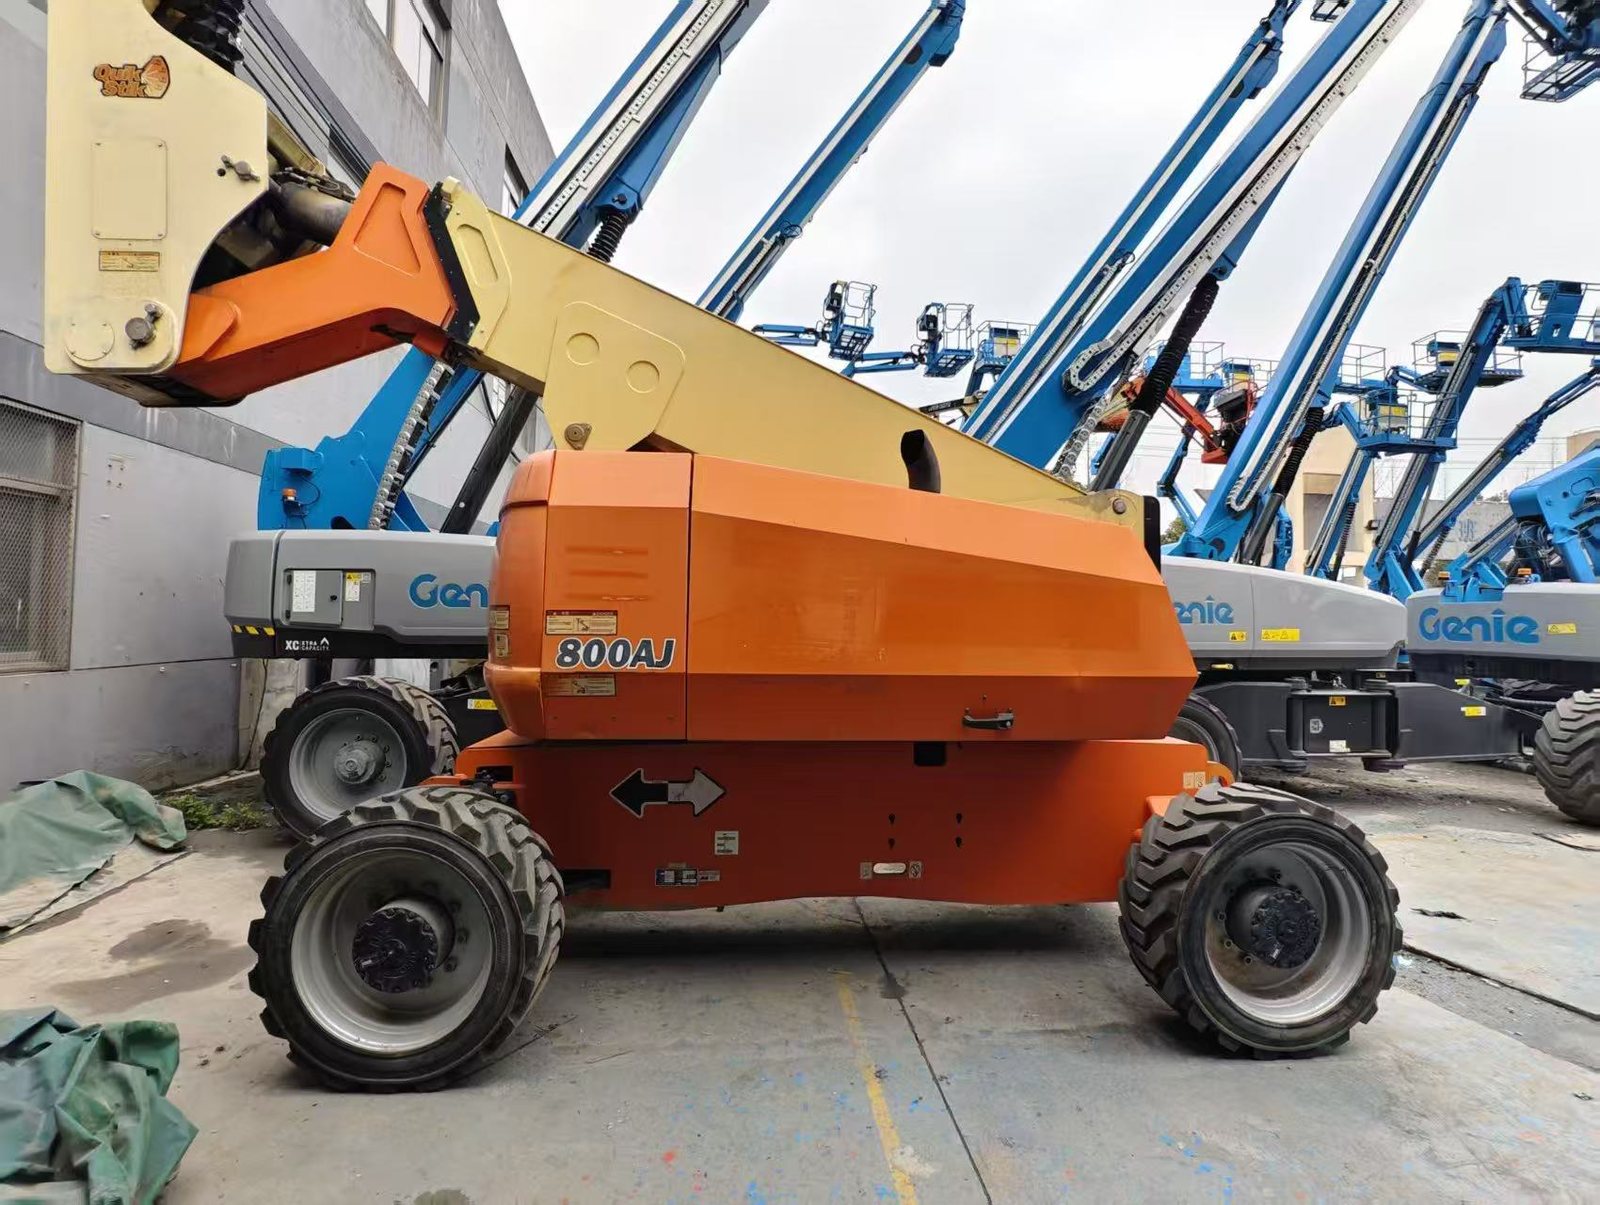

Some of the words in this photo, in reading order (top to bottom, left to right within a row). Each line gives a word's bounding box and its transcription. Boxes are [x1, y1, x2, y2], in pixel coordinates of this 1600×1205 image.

[409, 573, 488, 609] Gen
[1174, 595, 1234, 624] enie
[1419, 607, 1540, 644] Genie
[285, 640, 300, 650] XC
[556, 637, 676, 670] 800AJ
